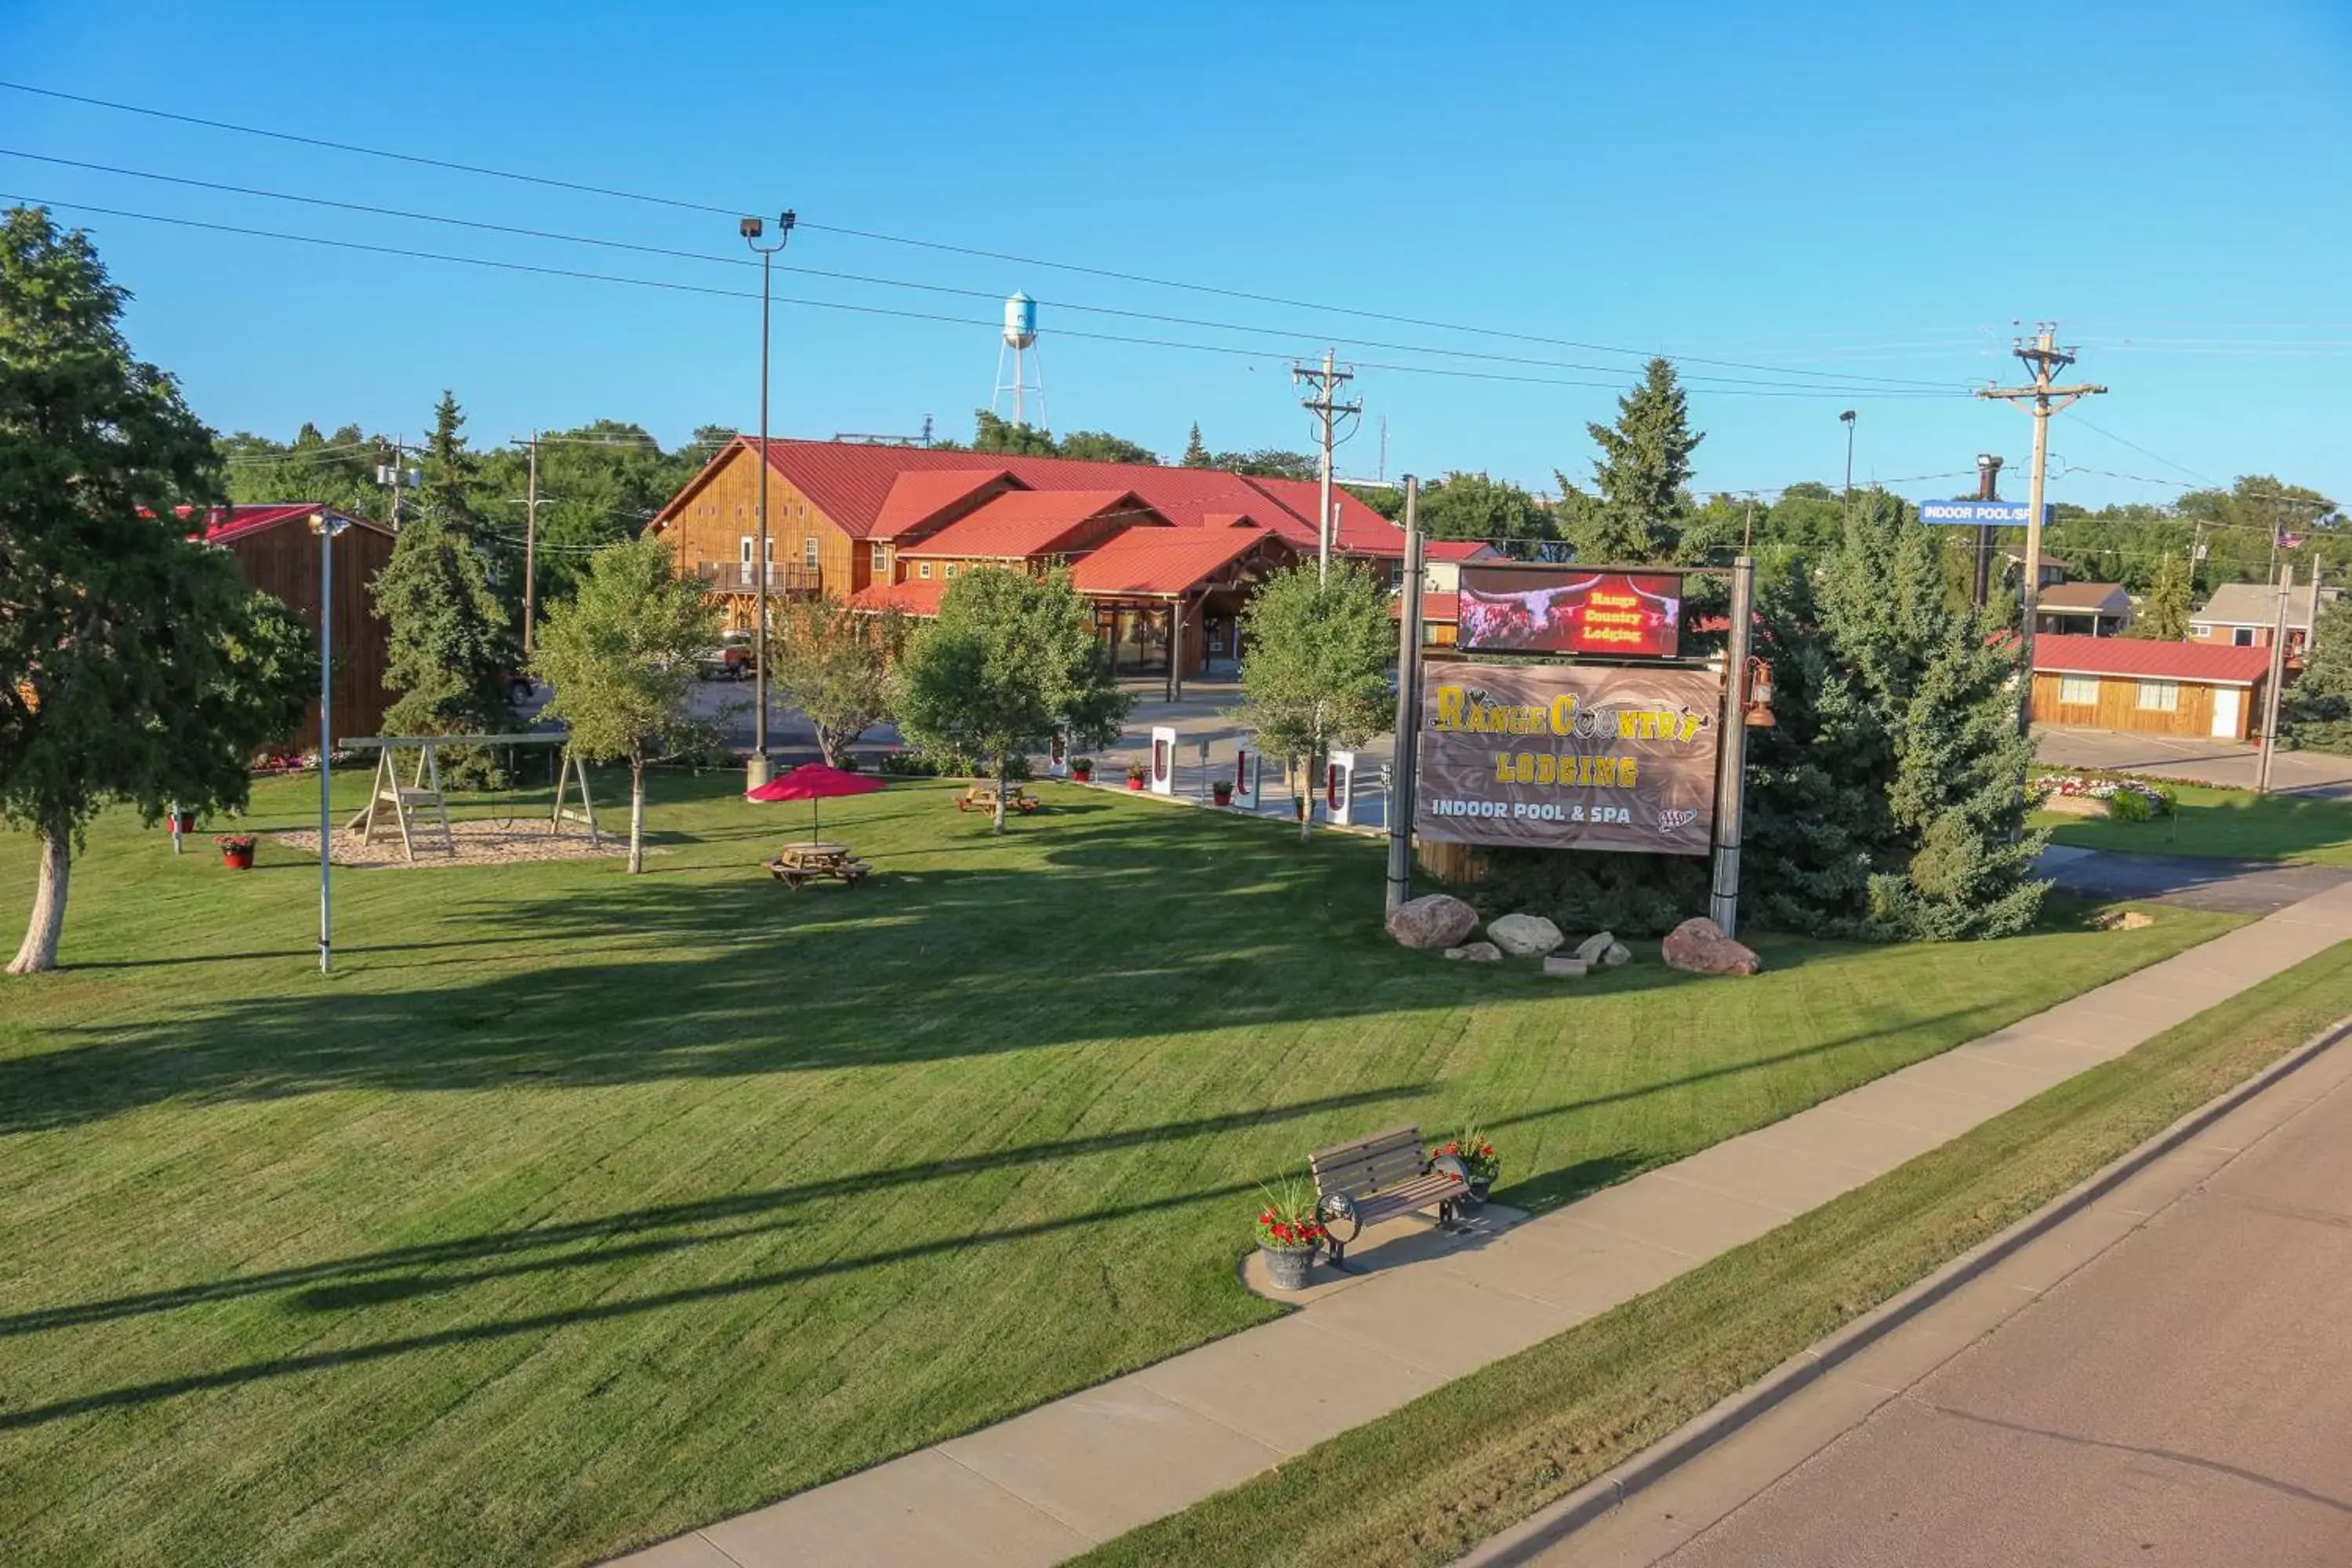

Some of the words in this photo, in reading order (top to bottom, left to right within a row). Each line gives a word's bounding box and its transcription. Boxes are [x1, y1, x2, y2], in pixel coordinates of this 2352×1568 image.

[1925, 506, 1973, 518] INDOOR
[1591, 592, 1638, 608] Range
[1584, 609, 1642, 625] Country
[1583, 626, 1642, 642] Lodging
[1495, 752, 1639, 788] LODGING
[1432, 799, 1508, 818] INDOOR
[1514, 802, 1565, 821] POOL
[1571, 805, 1584, 822] &
[1590, 807, 1631, 824] SPA
